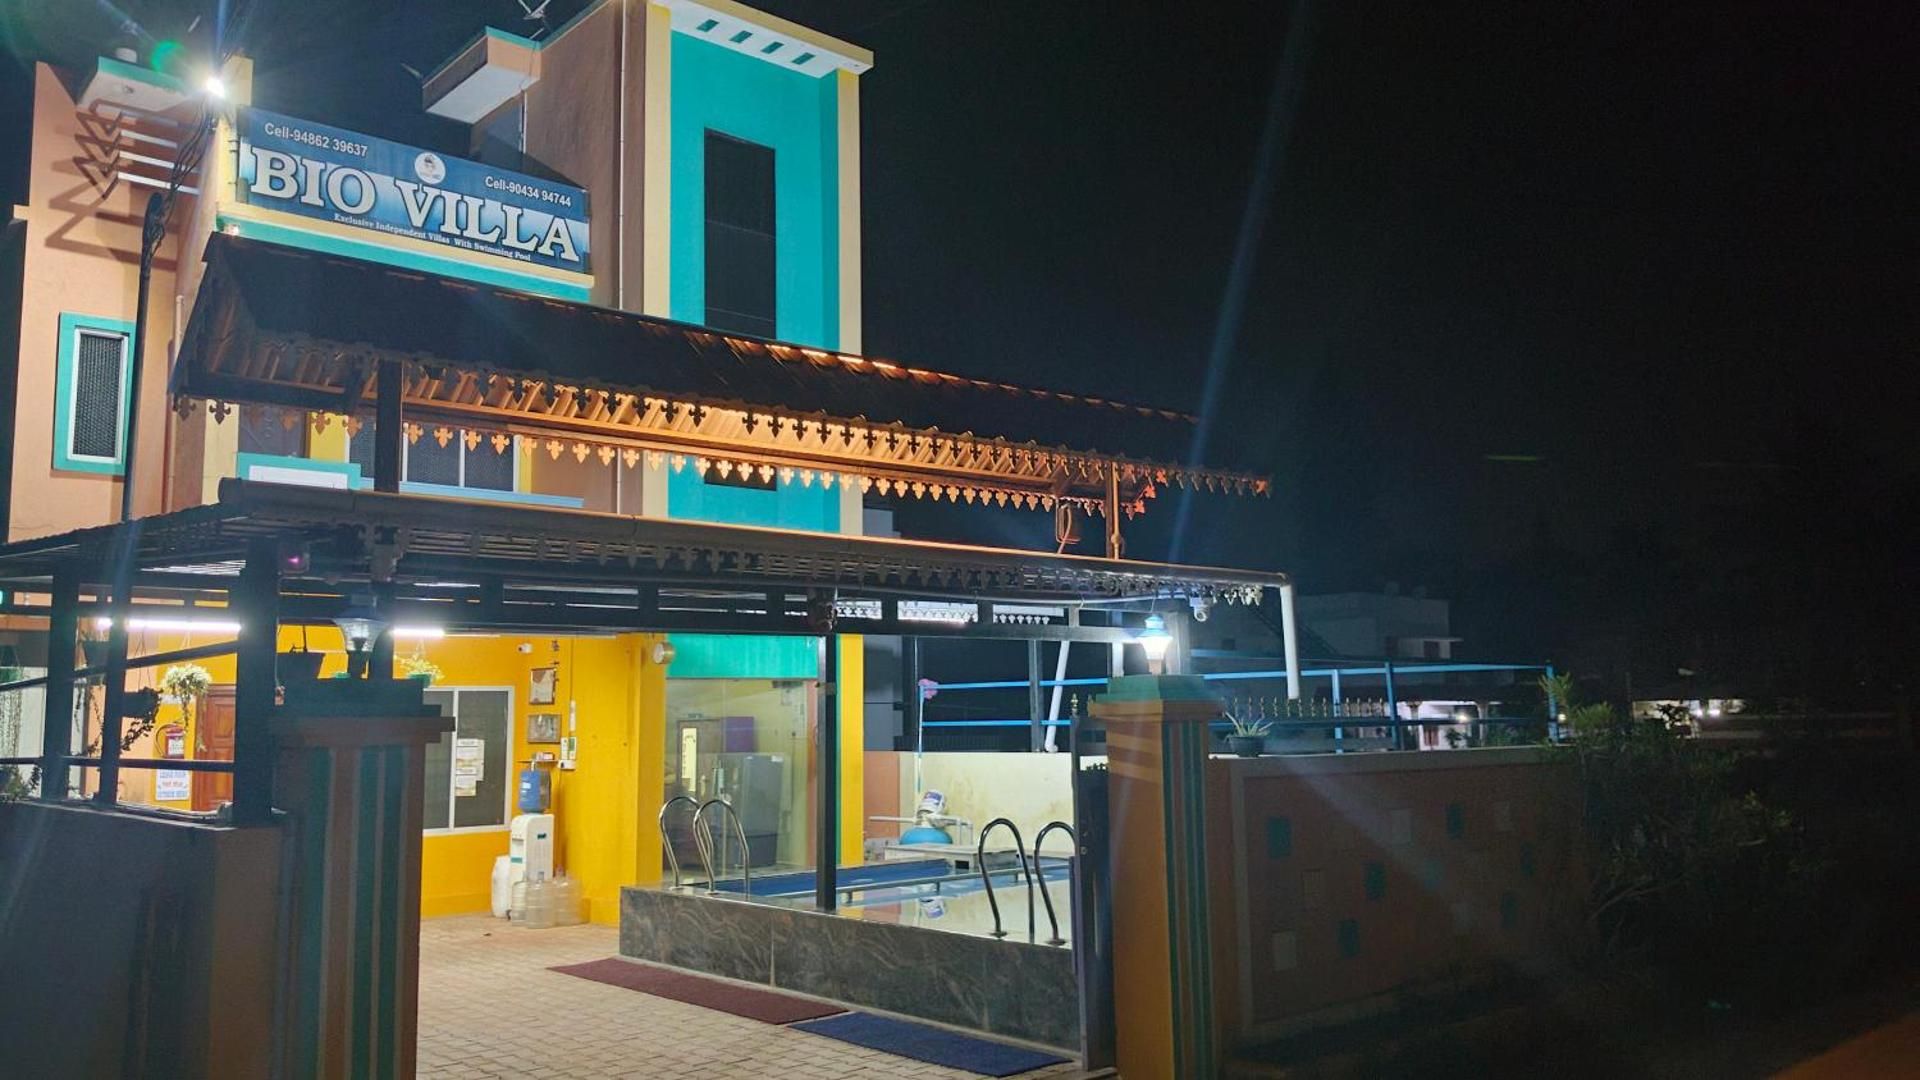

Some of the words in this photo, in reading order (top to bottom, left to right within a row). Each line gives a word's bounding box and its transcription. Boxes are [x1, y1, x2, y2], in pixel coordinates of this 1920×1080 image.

[264, 121, 329, 148] Cell-94862
[332, 138, 368, 157] 39637
[250, 146, 377, 215] BIO
[394, 178, 580, 262] VILLA
[485, 175, 540, 198] Cell-90434
[541, 190, 572, 207] 94744
[333, 212, 375, 229] Exclusive
[375, 221, 426, 238] Independent
[428, 232, 450, 245] Villas
[453, 237, 472, 249] With
[474, 242, 514, 258] Swimming
[514, 250, 532, 262] Pool
